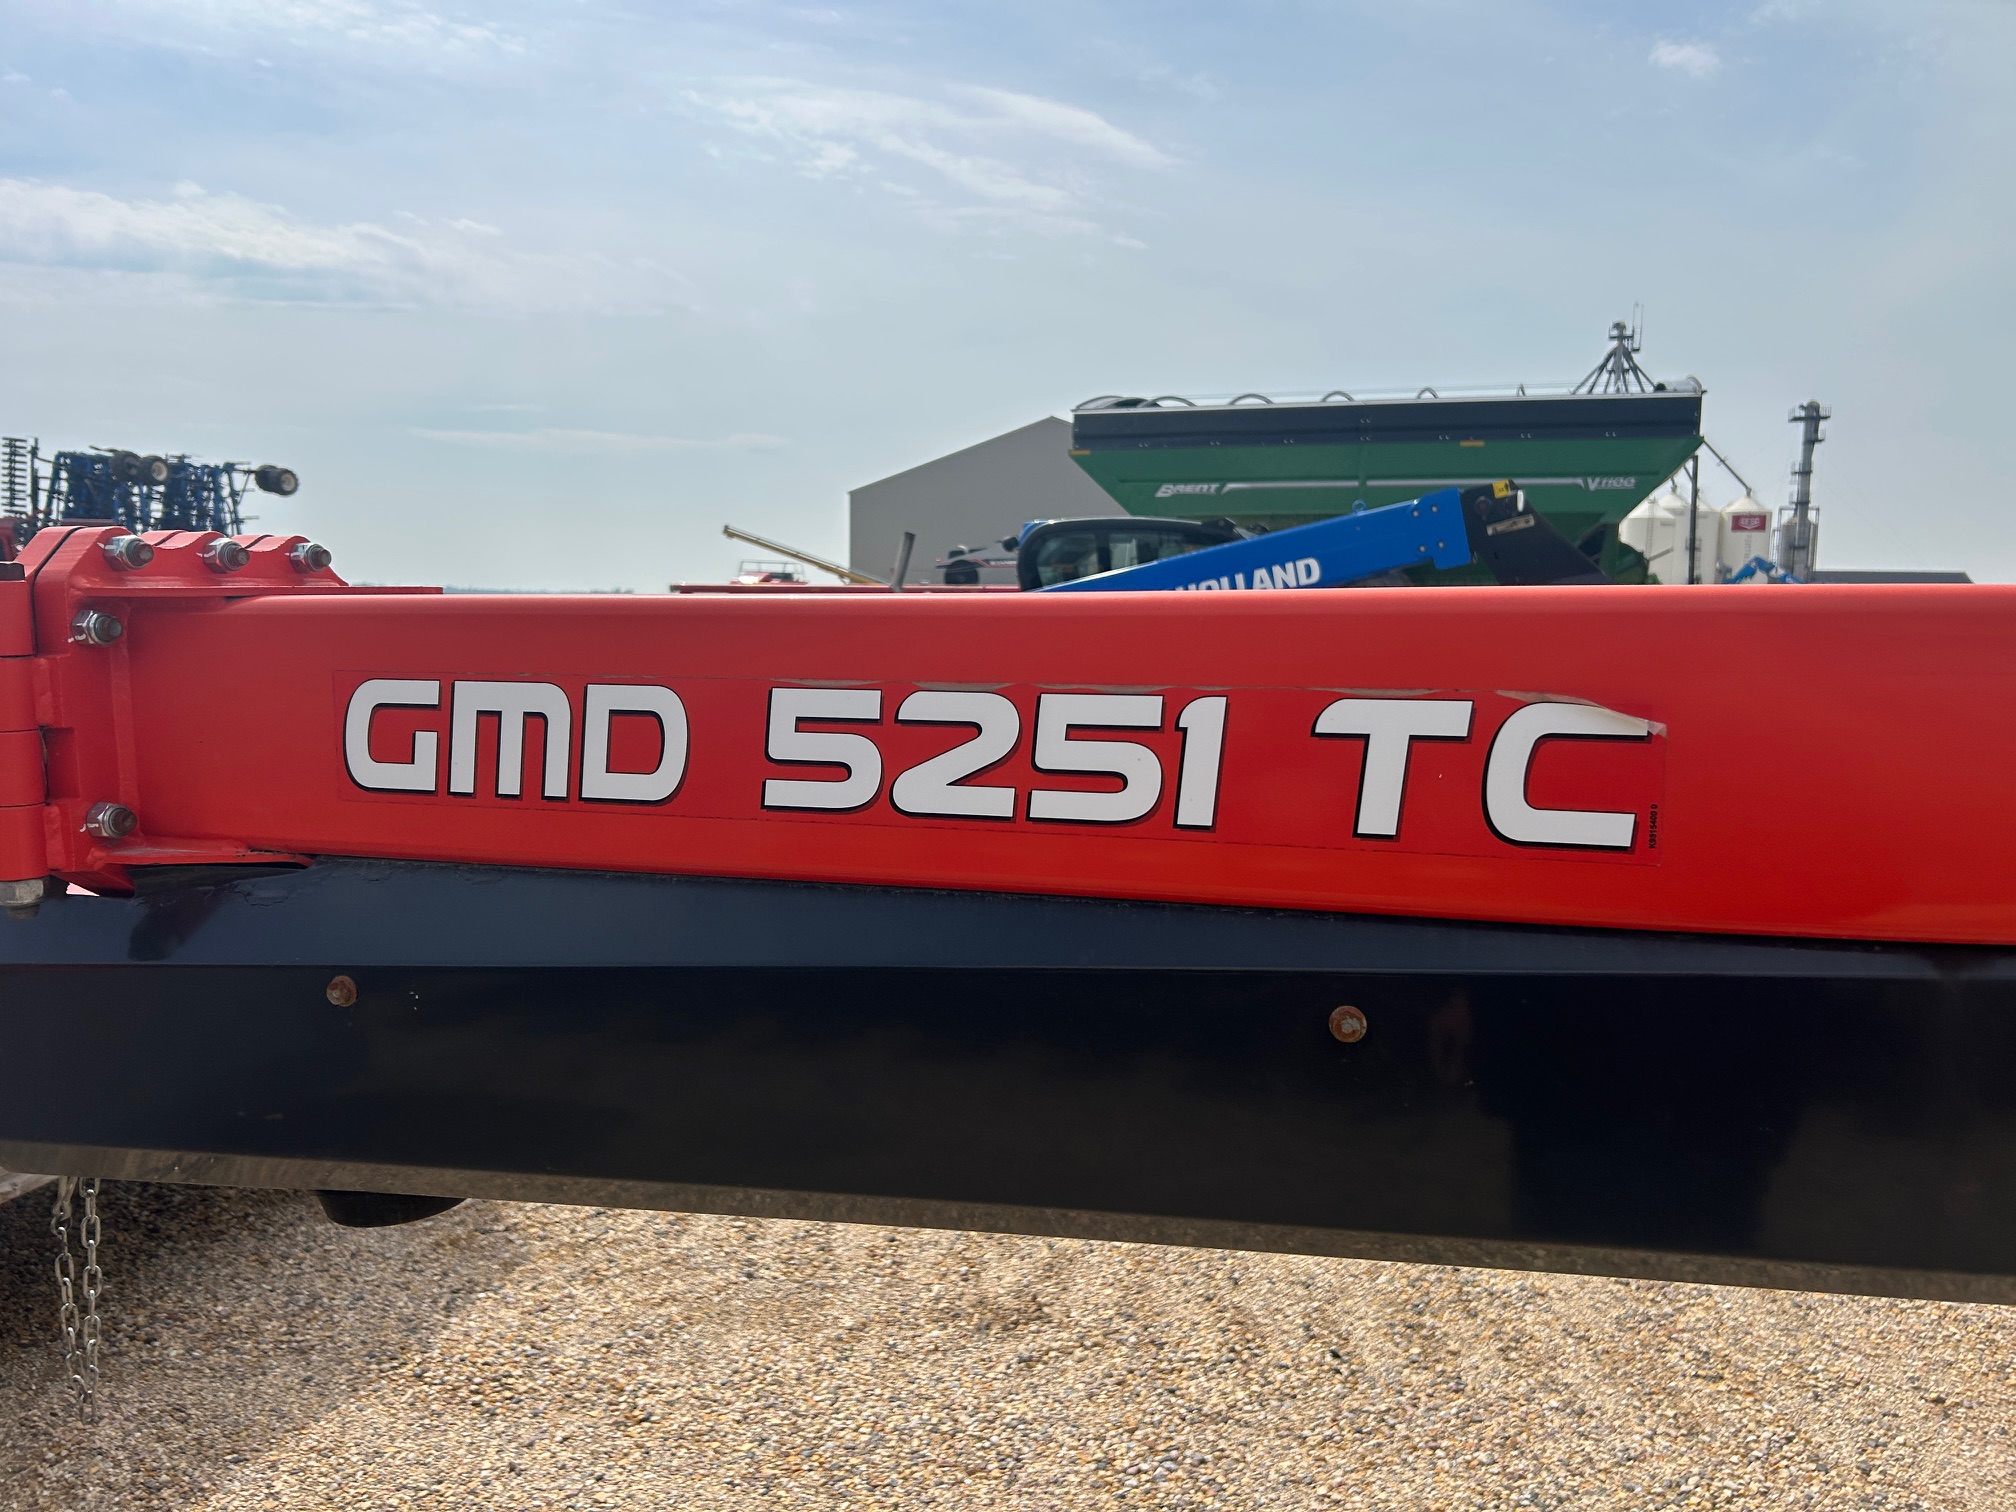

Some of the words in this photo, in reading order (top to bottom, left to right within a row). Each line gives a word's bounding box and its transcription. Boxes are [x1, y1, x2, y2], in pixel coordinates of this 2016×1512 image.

[1154, 483, 1220, 498] BRENT
[1174, 556, 1321, 591] LLAND
[343, 678, 690, 806] GMD
[761, 686, 1228, 831] 5251
[1310, 698, 1652, 853] TC
